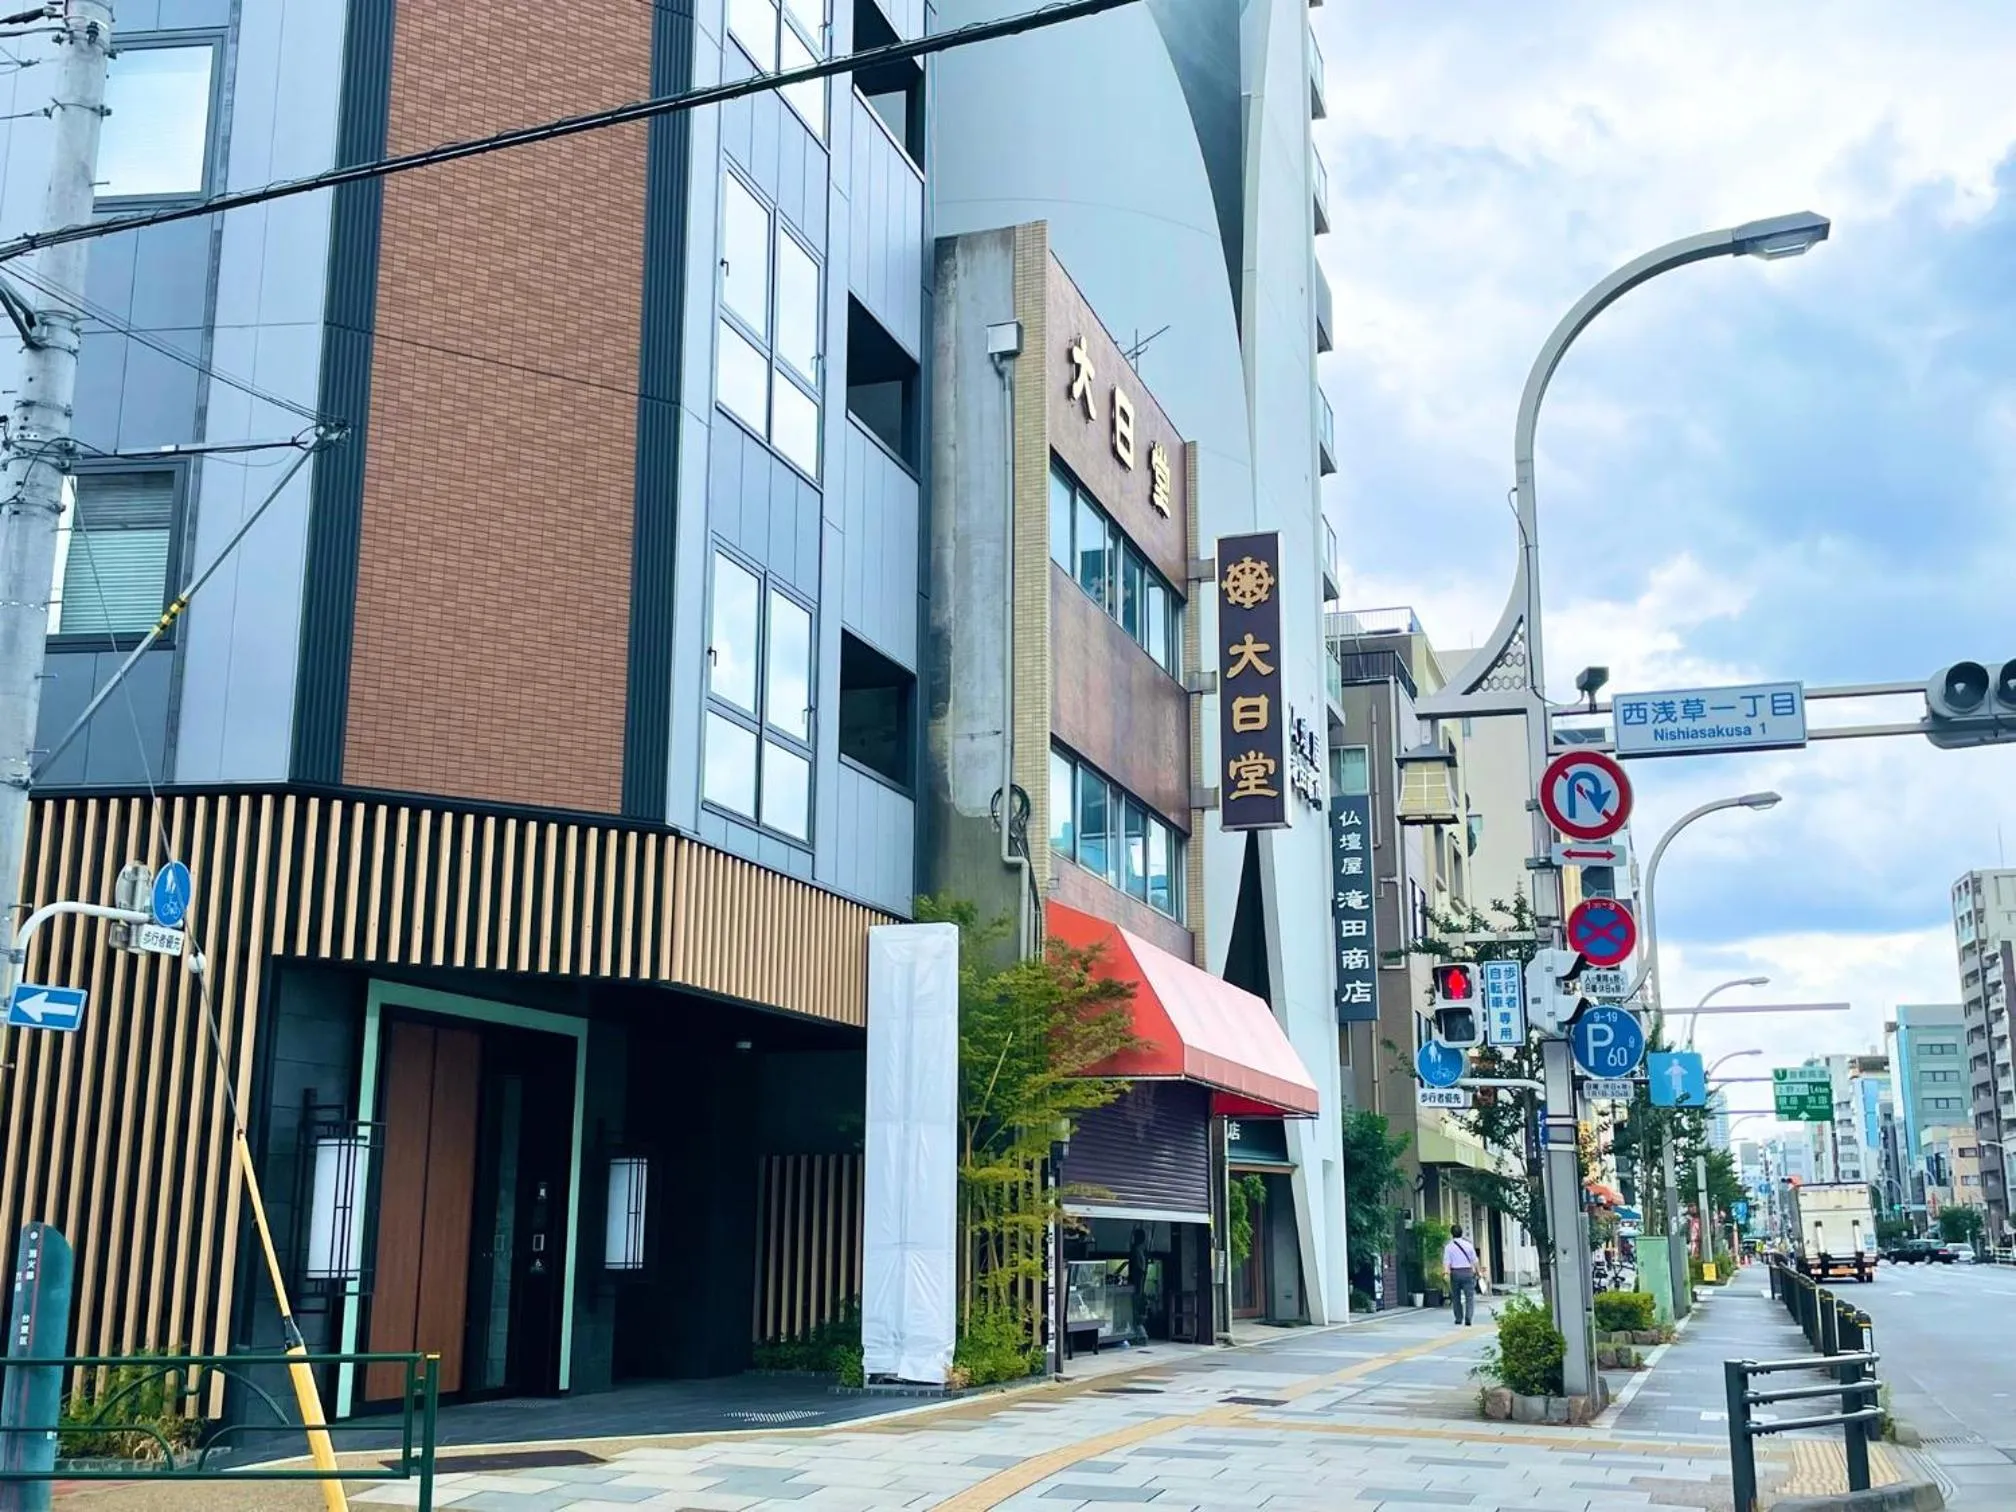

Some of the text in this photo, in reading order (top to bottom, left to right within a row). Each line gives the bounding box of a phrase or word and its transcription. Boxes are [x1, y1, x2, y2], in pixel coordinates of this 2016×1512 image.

[1069, 335, 1171, 519] 大日堂
[1226, 633, 1280, 800] 大日堂
[1621, 691, 1796, 726] 西浅草一丁目
[1653, 722, 1767, 742] Nishiasakusa 1
[1337, 810, 1373, 1004] 仏壇屋 滝田商店
[1586, 1023, 1615, 1067] P
[1607, 1046, 1628, 1067] 60
[1420, 1092, 1461, 1104] 歩行者優先
